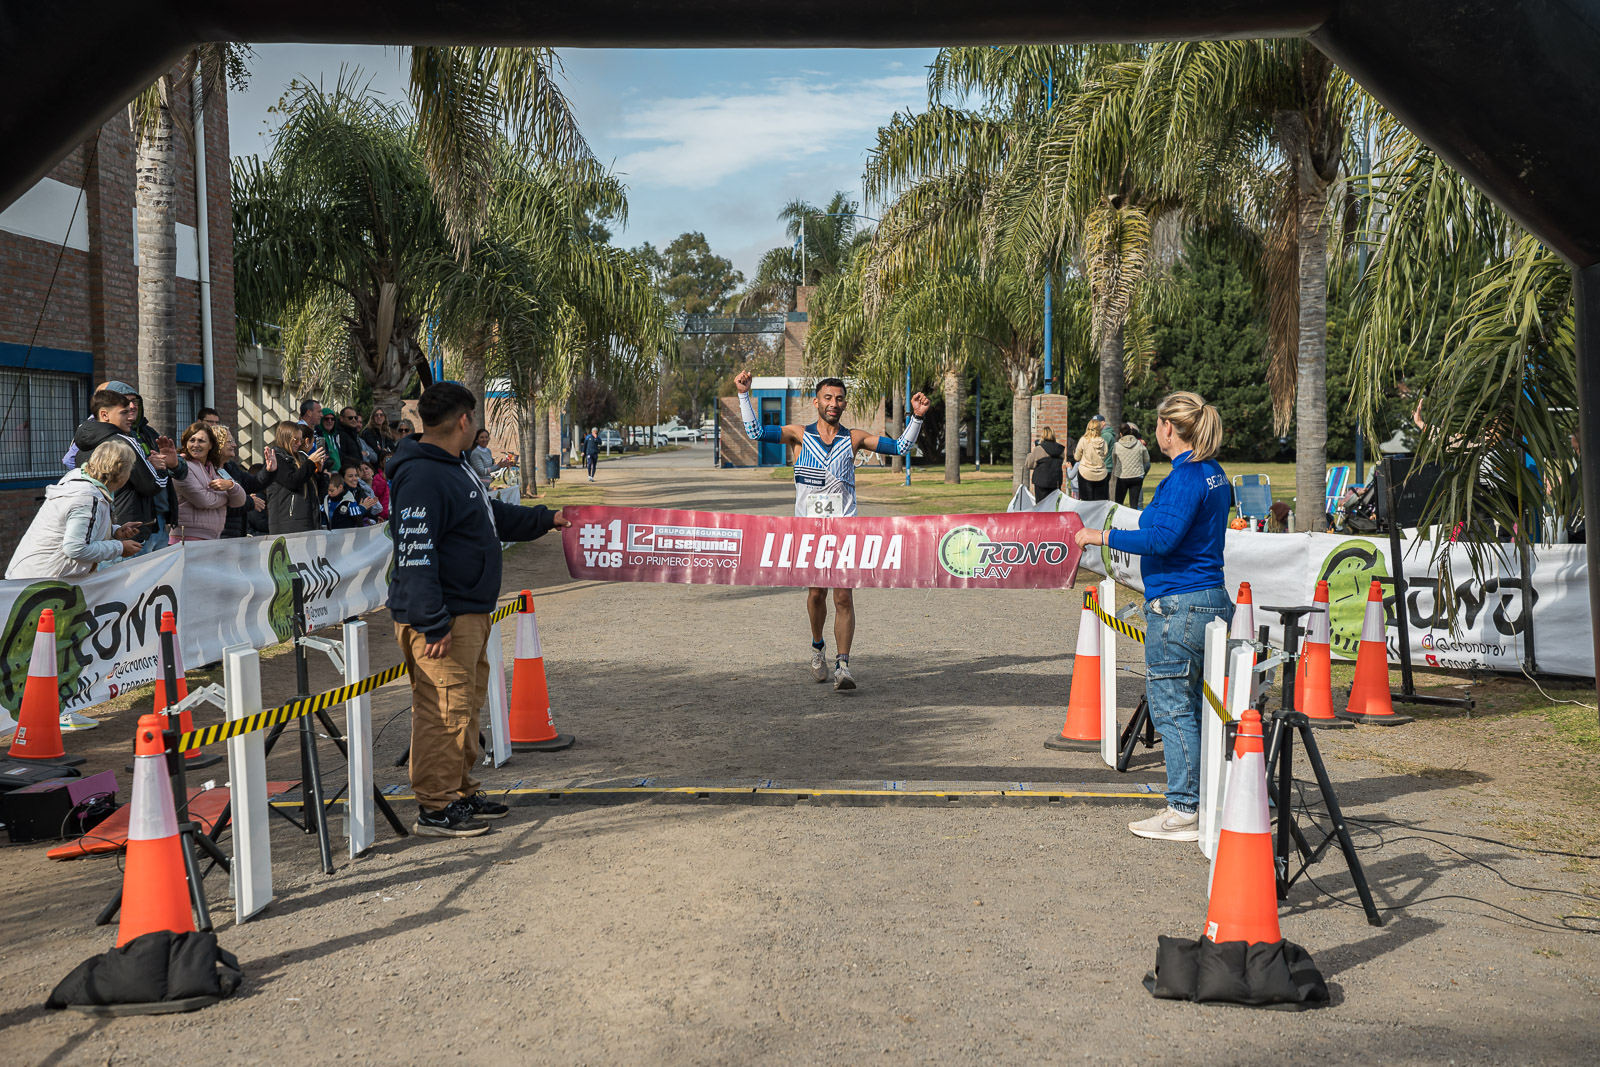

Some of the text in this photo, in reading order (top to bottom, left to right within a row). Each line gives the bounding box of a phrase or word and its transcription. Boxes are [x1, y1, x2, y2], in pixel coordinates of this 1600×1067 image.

[814, 501, 834, 514] 84
[404, 523, 428, 539] pueblo
[579, 519, 624, 551] #1
[658, 528, 738, 538] GRUPO ASEGURADOR
[407, 539, 433, 555] grande
[674, 538, 738, 552] segunda
[759, 532, 903, 570] LLEGADA
[583, 551, 623, 568] VOS
[629, 555, 738, 569] LO PRIMERO SOS VOS
[973, 566, 1012, 579] RAV
[1435, 637, 1507, 657] @cronorav
[115, 654, 159, 679] @cronora
